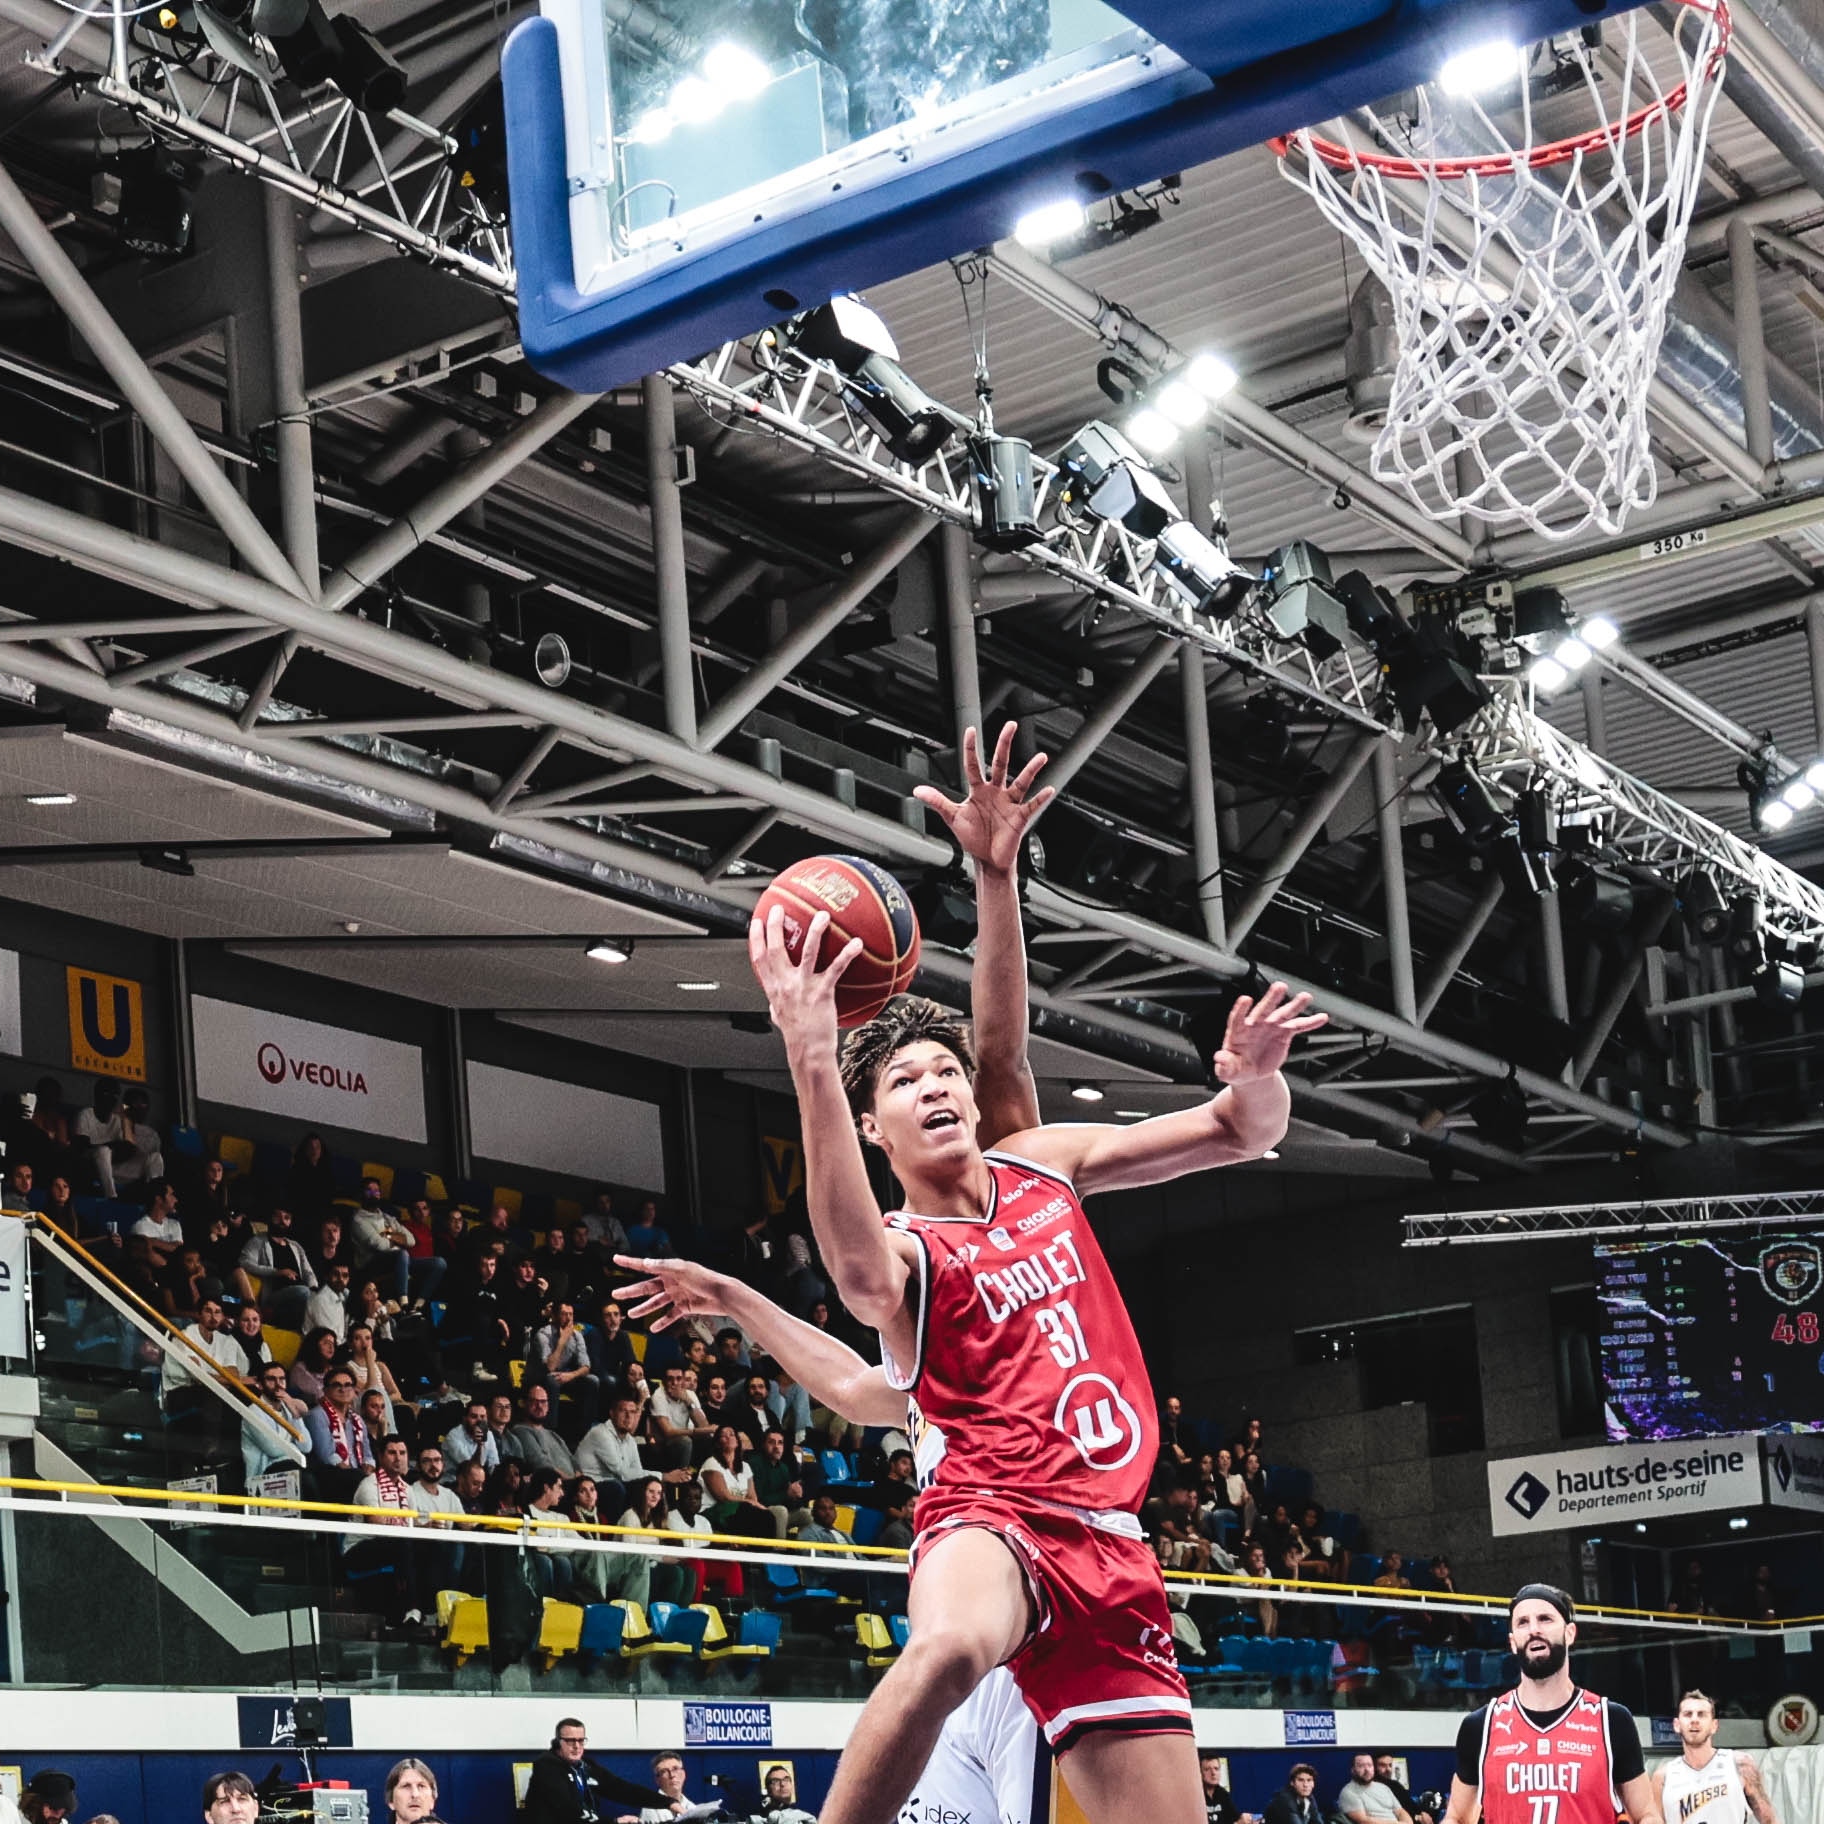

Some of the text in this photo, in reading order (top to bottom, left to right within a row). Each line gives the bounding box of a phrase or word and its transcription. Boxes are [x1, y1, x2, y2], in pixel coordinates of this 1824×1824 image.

[1653, 532, 1704, 555] 350 Kg
[79, 975, 131, 1058] U
[289, 1058, 368, 1095] VEOLIA
[973, 1229, 1087, 1325] CHOLET
[1034, 1299, 1090, 1369] 31
[1771, 1312, 1821, 1344] 48
[1656, 1480, 1708, 1502] Sportif
[705, 1708, 771, 1725] BOULOGNE-
[706, 1725, 772, 1742] BILLANCOURT
[1505, 1761, 1582, 1795] CHOLET
[1679, 1783, 1729, 1821] METS92
